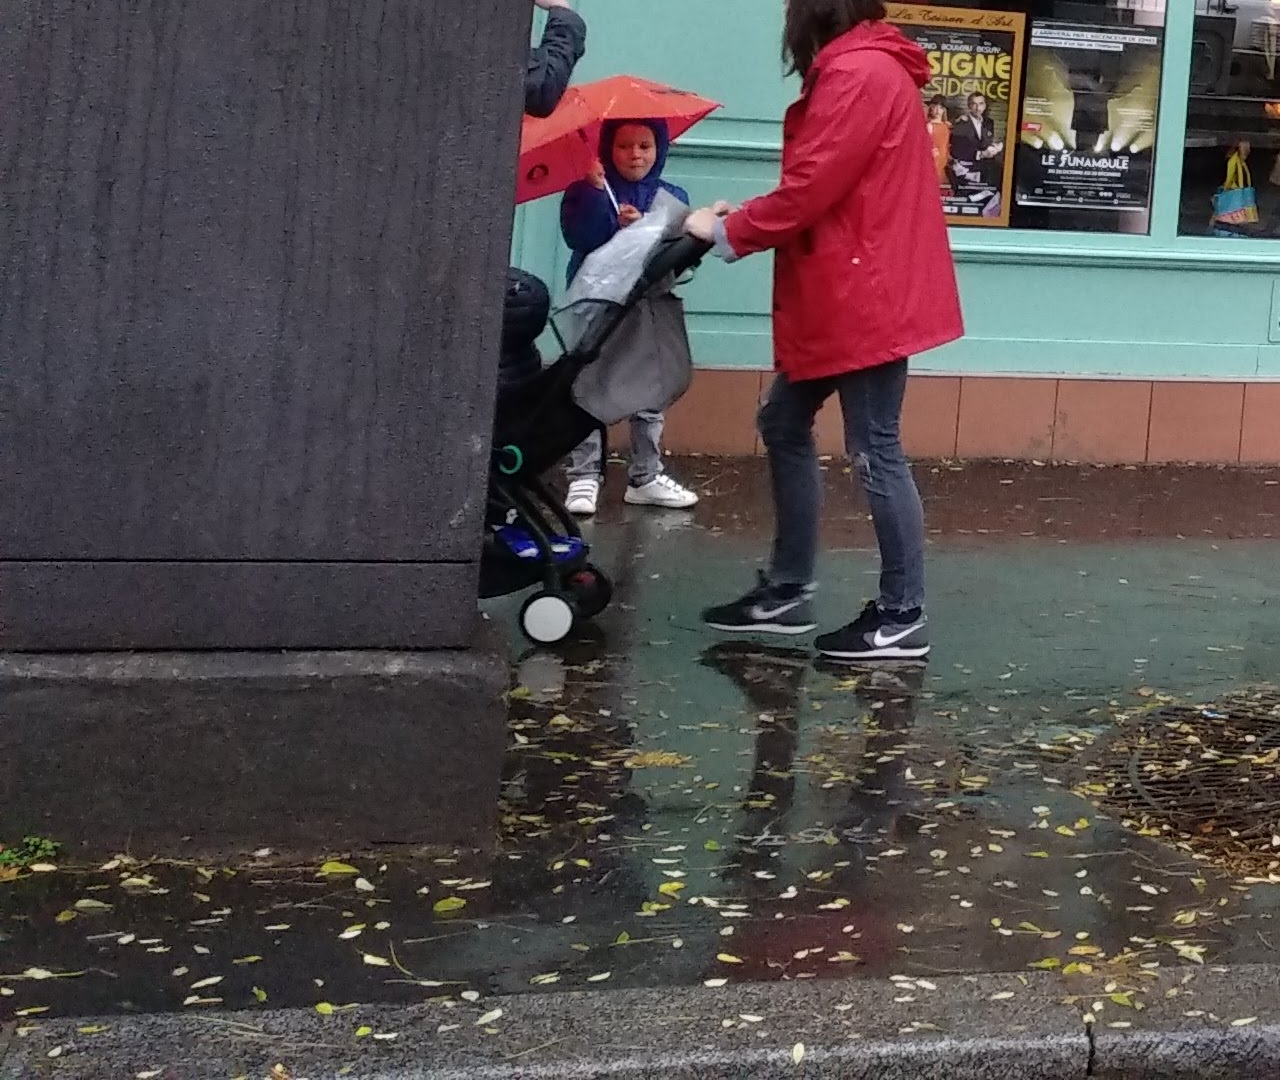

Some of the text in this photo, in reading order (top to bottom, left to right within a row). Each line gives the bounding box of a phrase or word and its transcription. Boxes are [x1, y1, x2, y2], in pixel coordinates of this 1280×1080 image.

[927, 51, 1011, 80] SIGNÉ
[1041, 150, 1129, 170] LE FUNAMBULE
